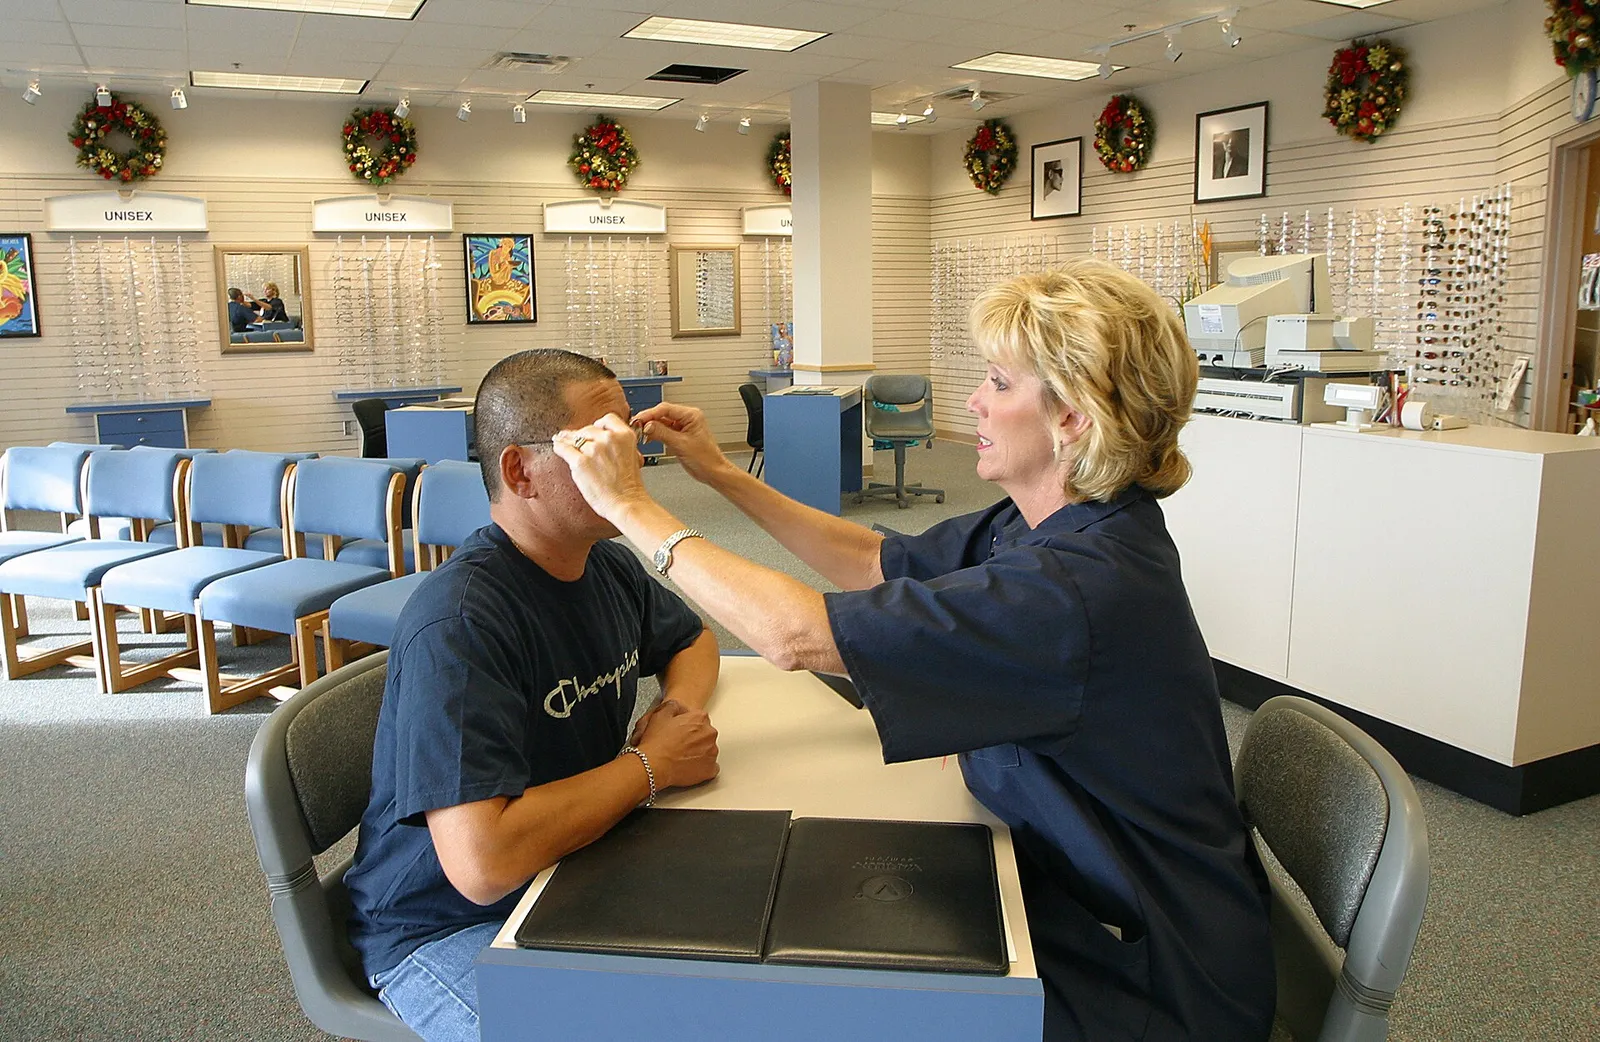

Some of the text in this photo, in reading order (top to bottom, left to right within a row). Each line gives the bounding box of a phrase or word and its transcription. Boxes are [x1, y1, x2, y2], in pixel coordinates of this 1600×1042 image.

[104, 211, 153, 221] UNISEX
[365, 212, 407, 222] UNISEX
[589, 215, 626, 225] UNISEX
[543, 647, 639, 719] Champio
